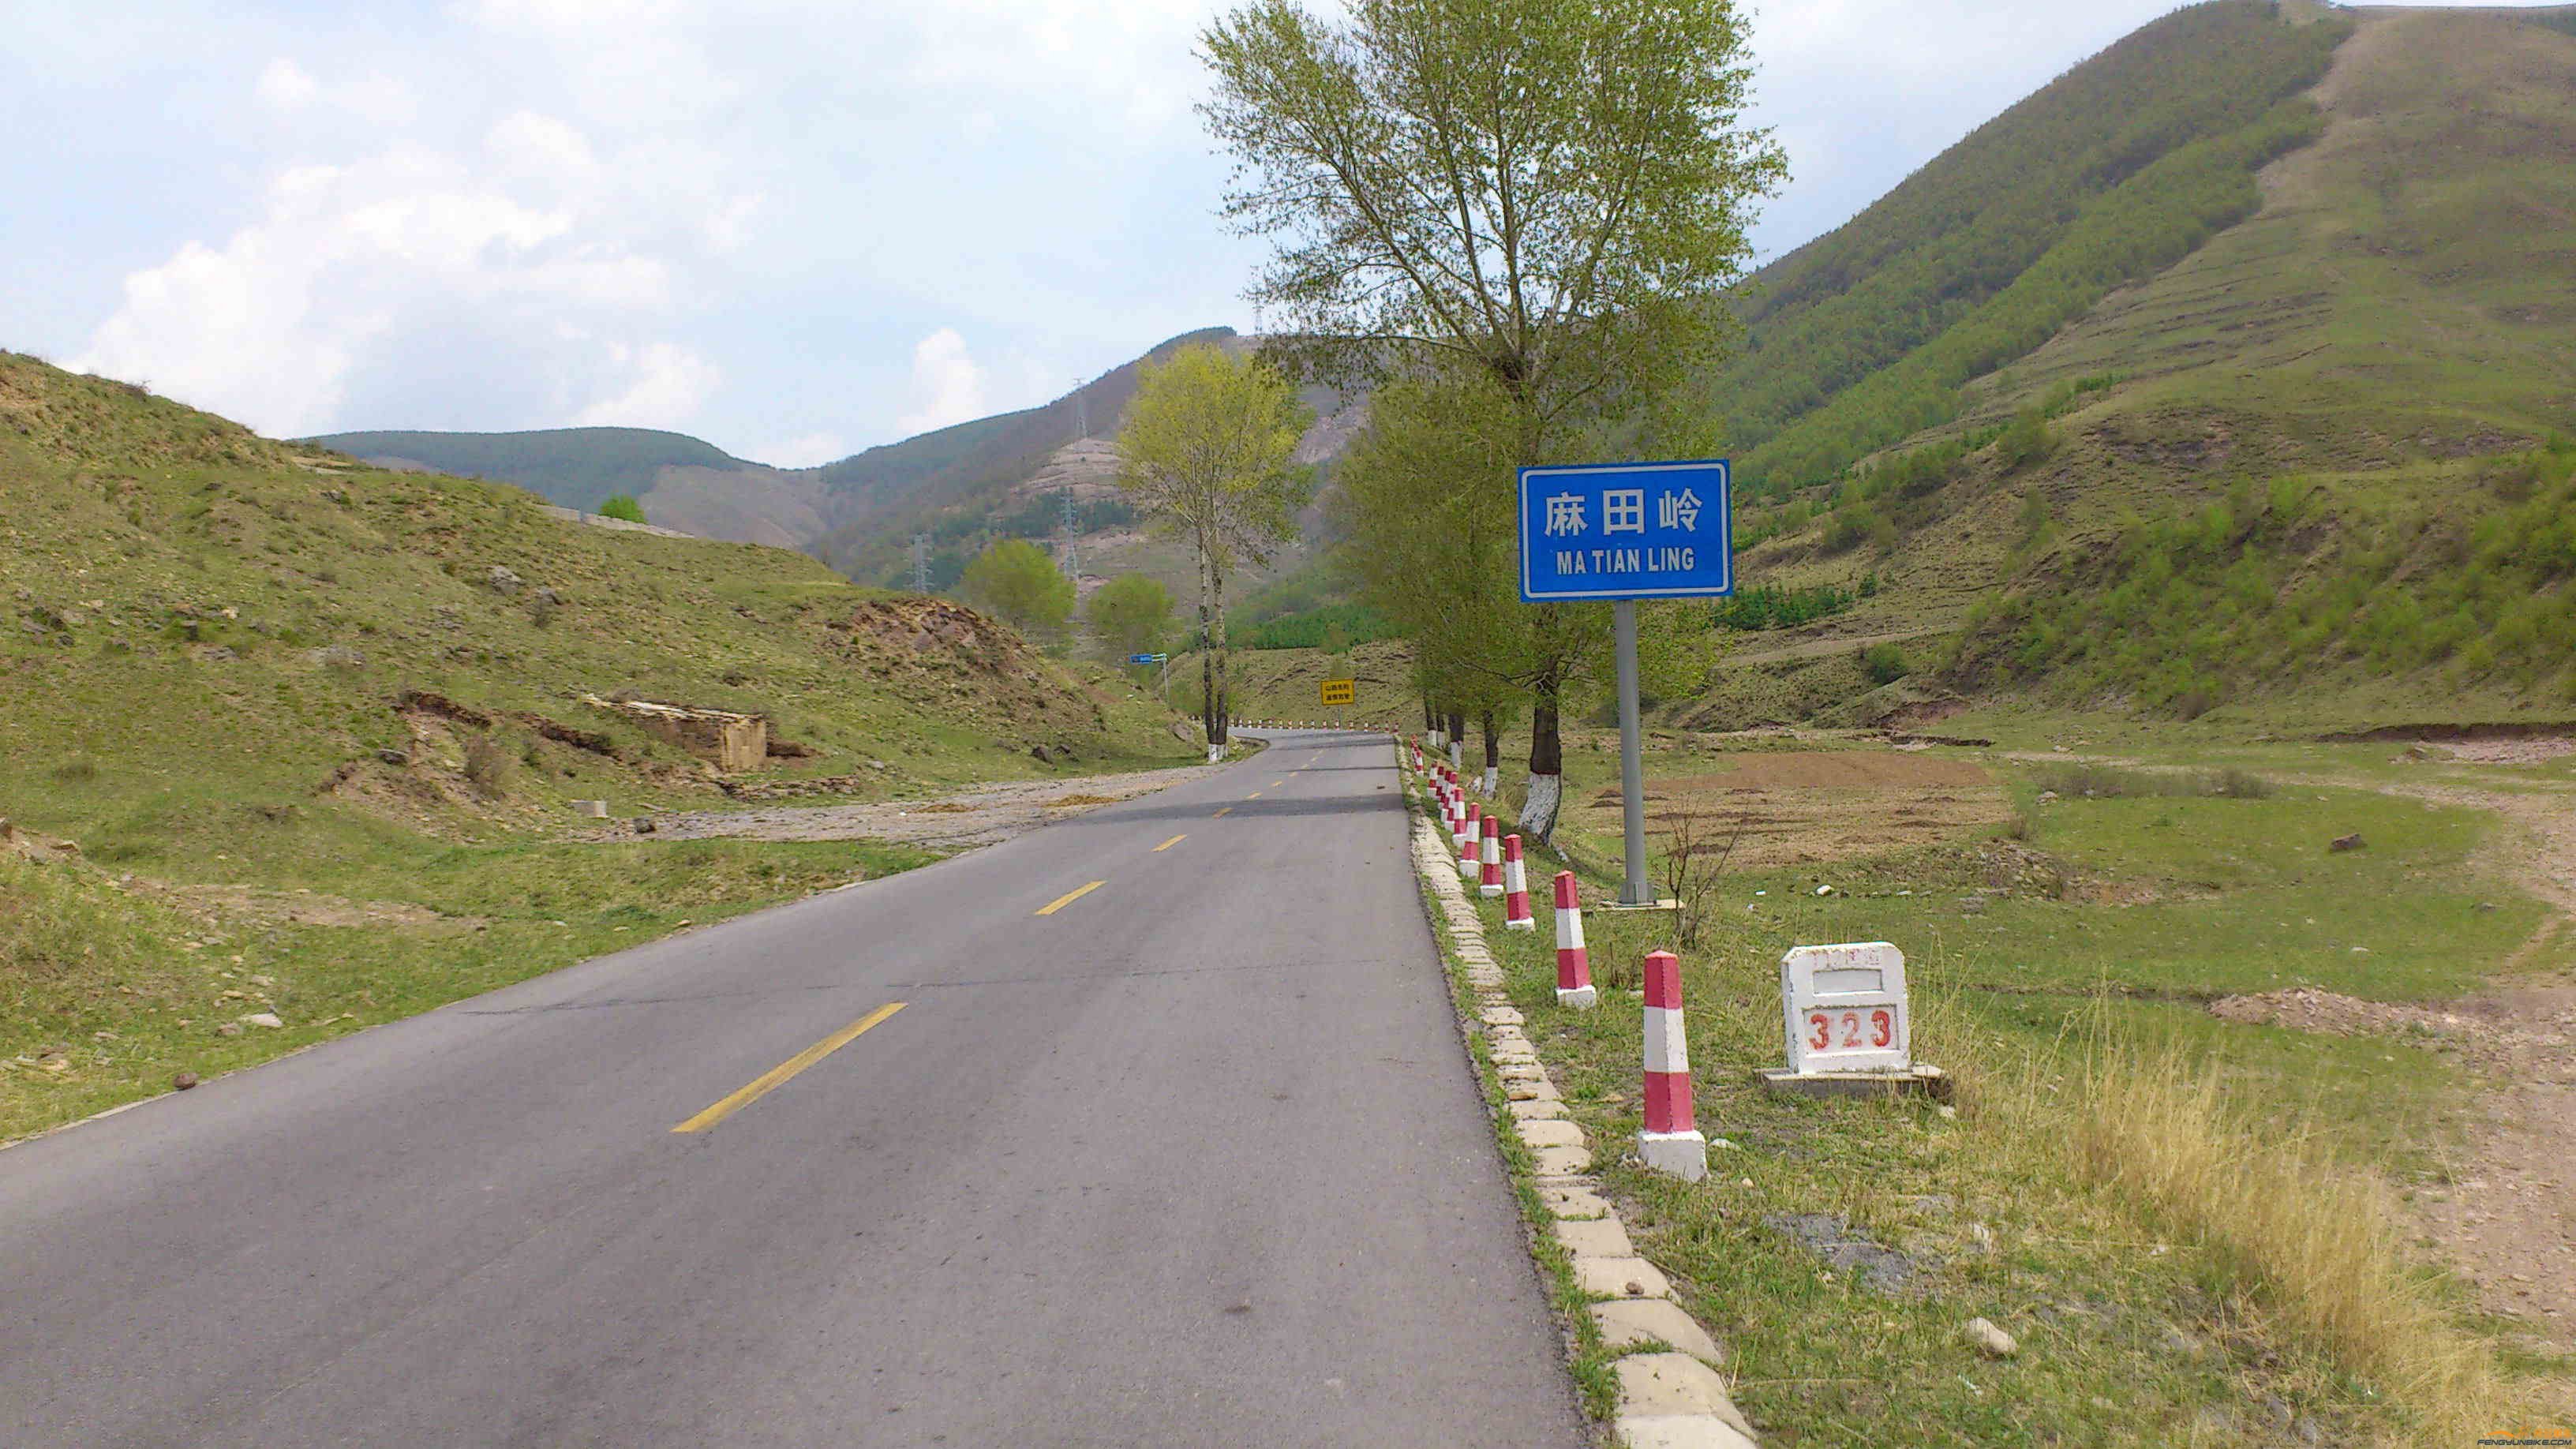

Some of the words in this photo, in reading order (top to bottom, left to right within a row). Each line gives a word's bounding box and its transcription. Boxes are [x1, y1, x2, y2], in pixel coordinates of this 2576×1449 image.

[1544, 488, 1702, 537] 麻田岭
[1556, 550, 1586, 575] MA
[1592, 549, 1641, 574] TIAN
[1647, 547, 1694, 572] LING
[1809, 1009, 1891, 1050] 323
